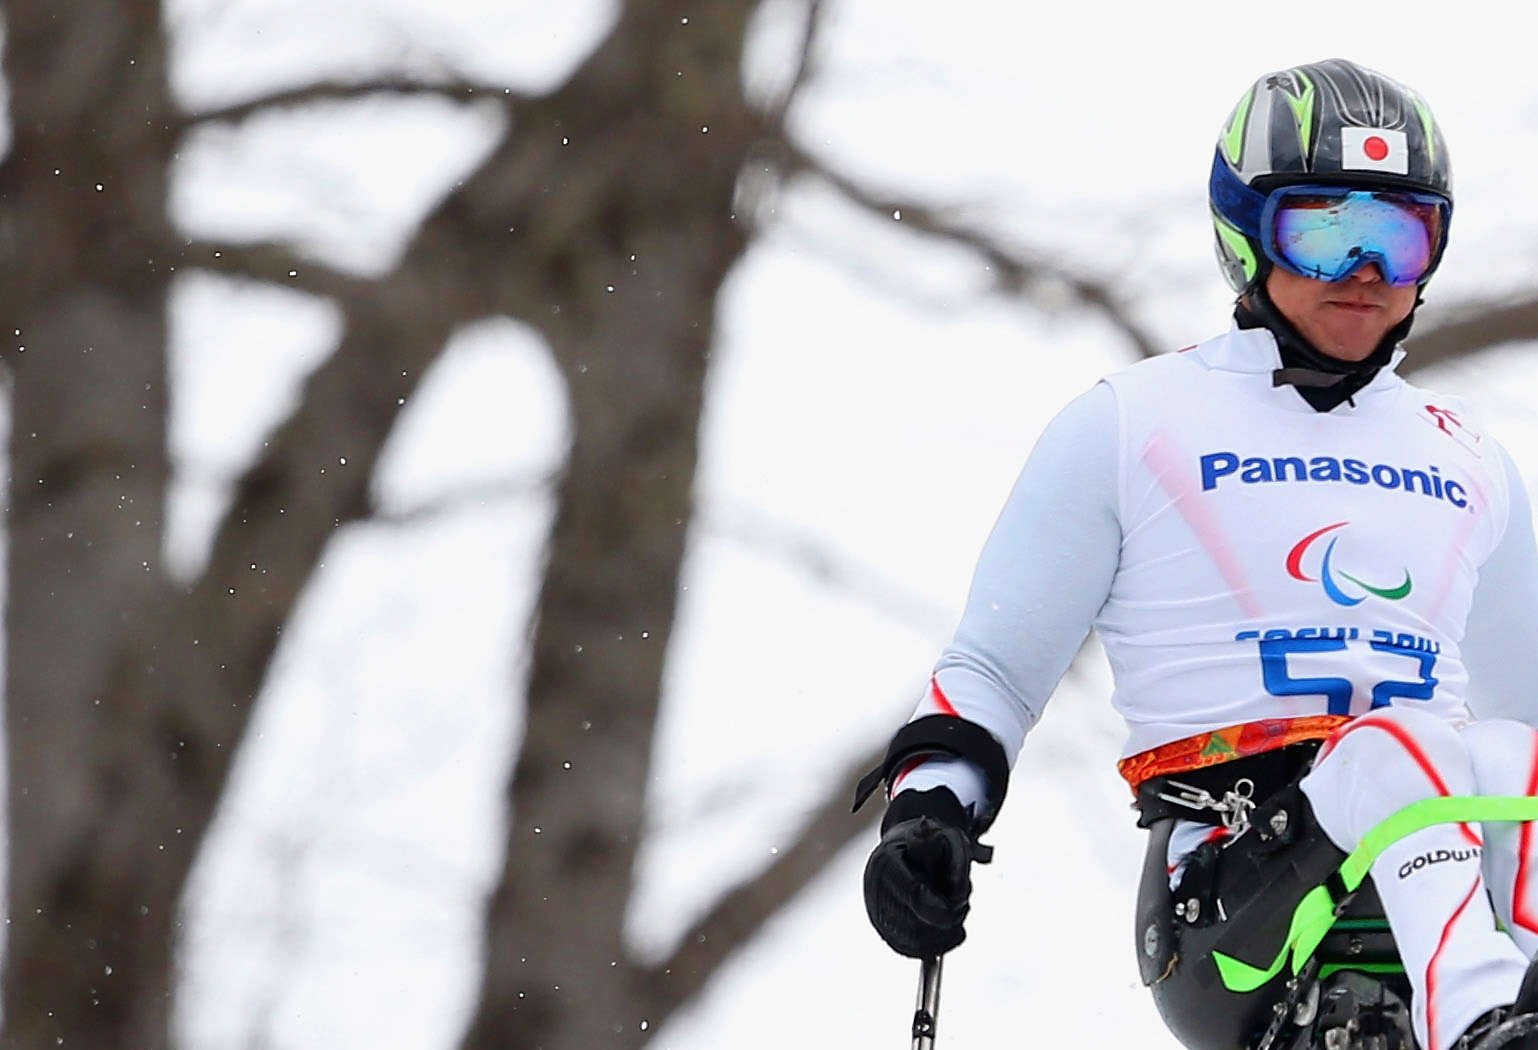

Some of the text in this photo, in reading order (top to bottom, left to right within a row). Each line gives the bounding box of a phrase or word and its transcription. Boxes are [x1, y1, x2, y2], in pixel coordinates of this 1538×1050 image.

[1200, 452, 1467, 508] Panasonic
[1259, 638, 1438, 715] 52
[1398, 848, 1478, 879] GOLDWI
